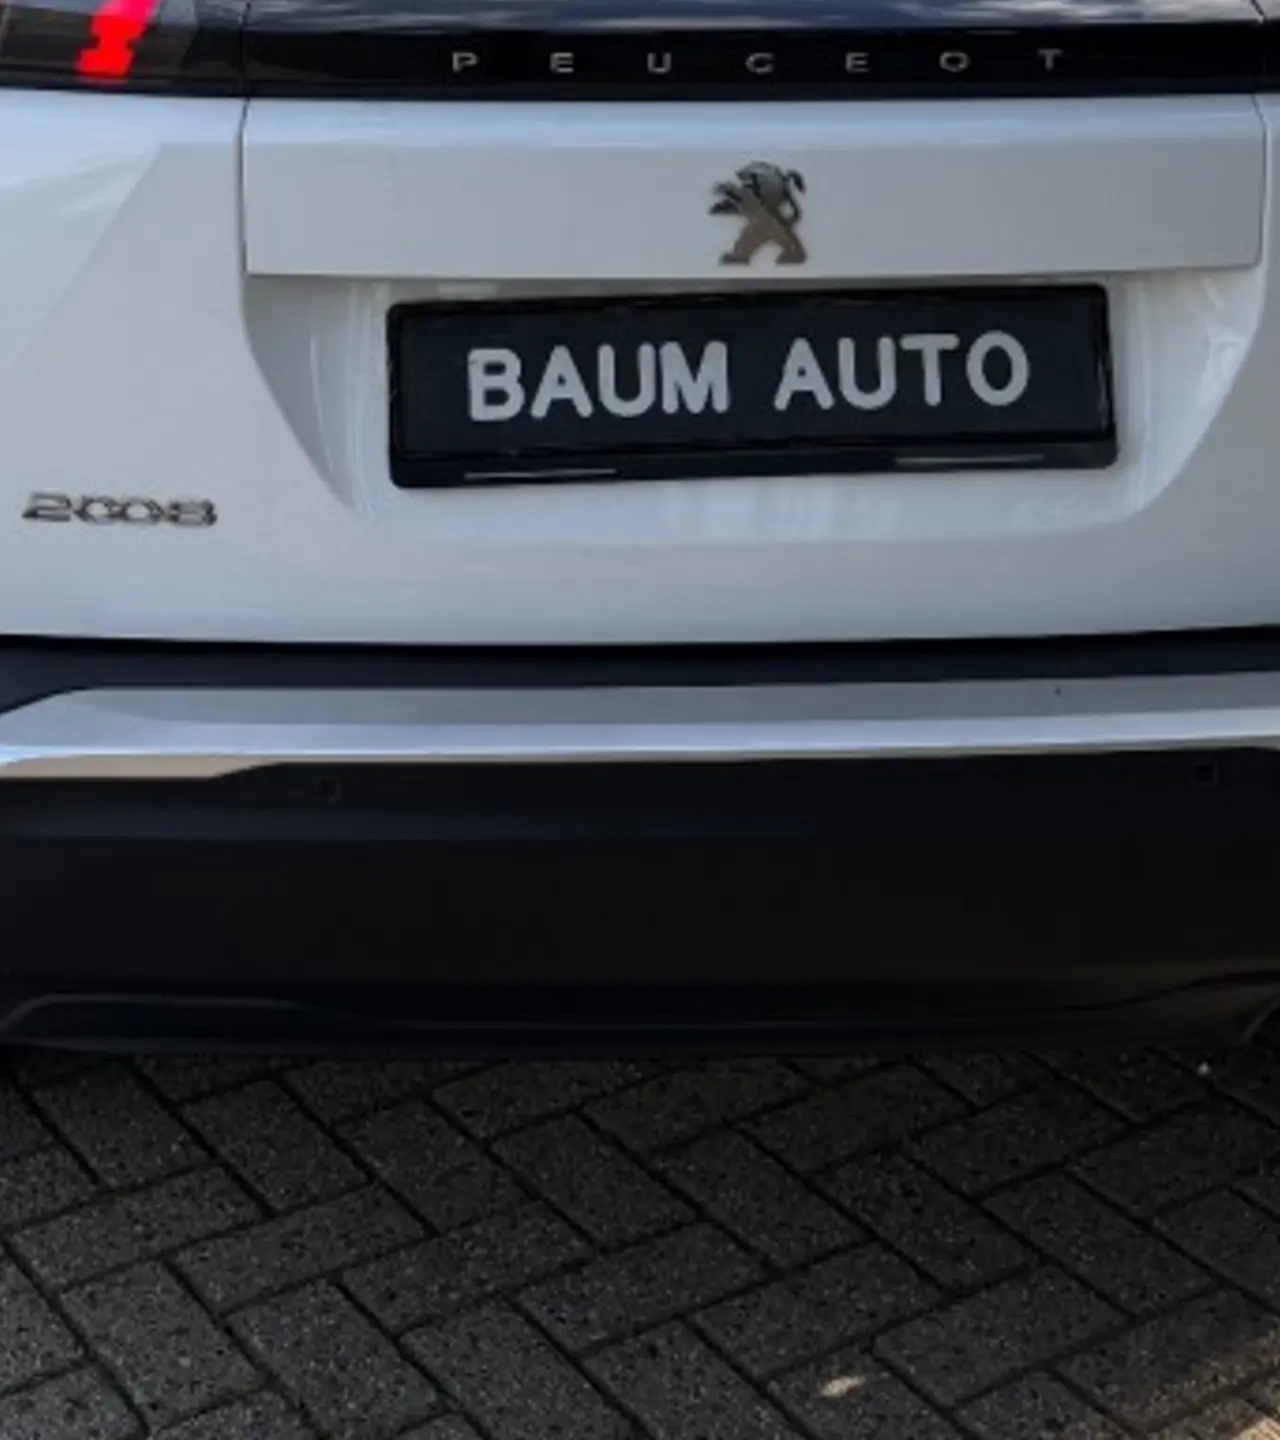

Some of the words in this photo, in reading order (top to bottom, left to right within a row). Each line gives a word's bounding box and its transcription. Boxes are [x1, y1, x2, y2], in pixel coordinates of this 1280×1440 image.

[450, 48, 1063, 75] PEUGEOT
[466, 340, 730, 422] BAUM
[773, 330, 1030, 412] AUTO
[21, 491, 218, 527] 2008
